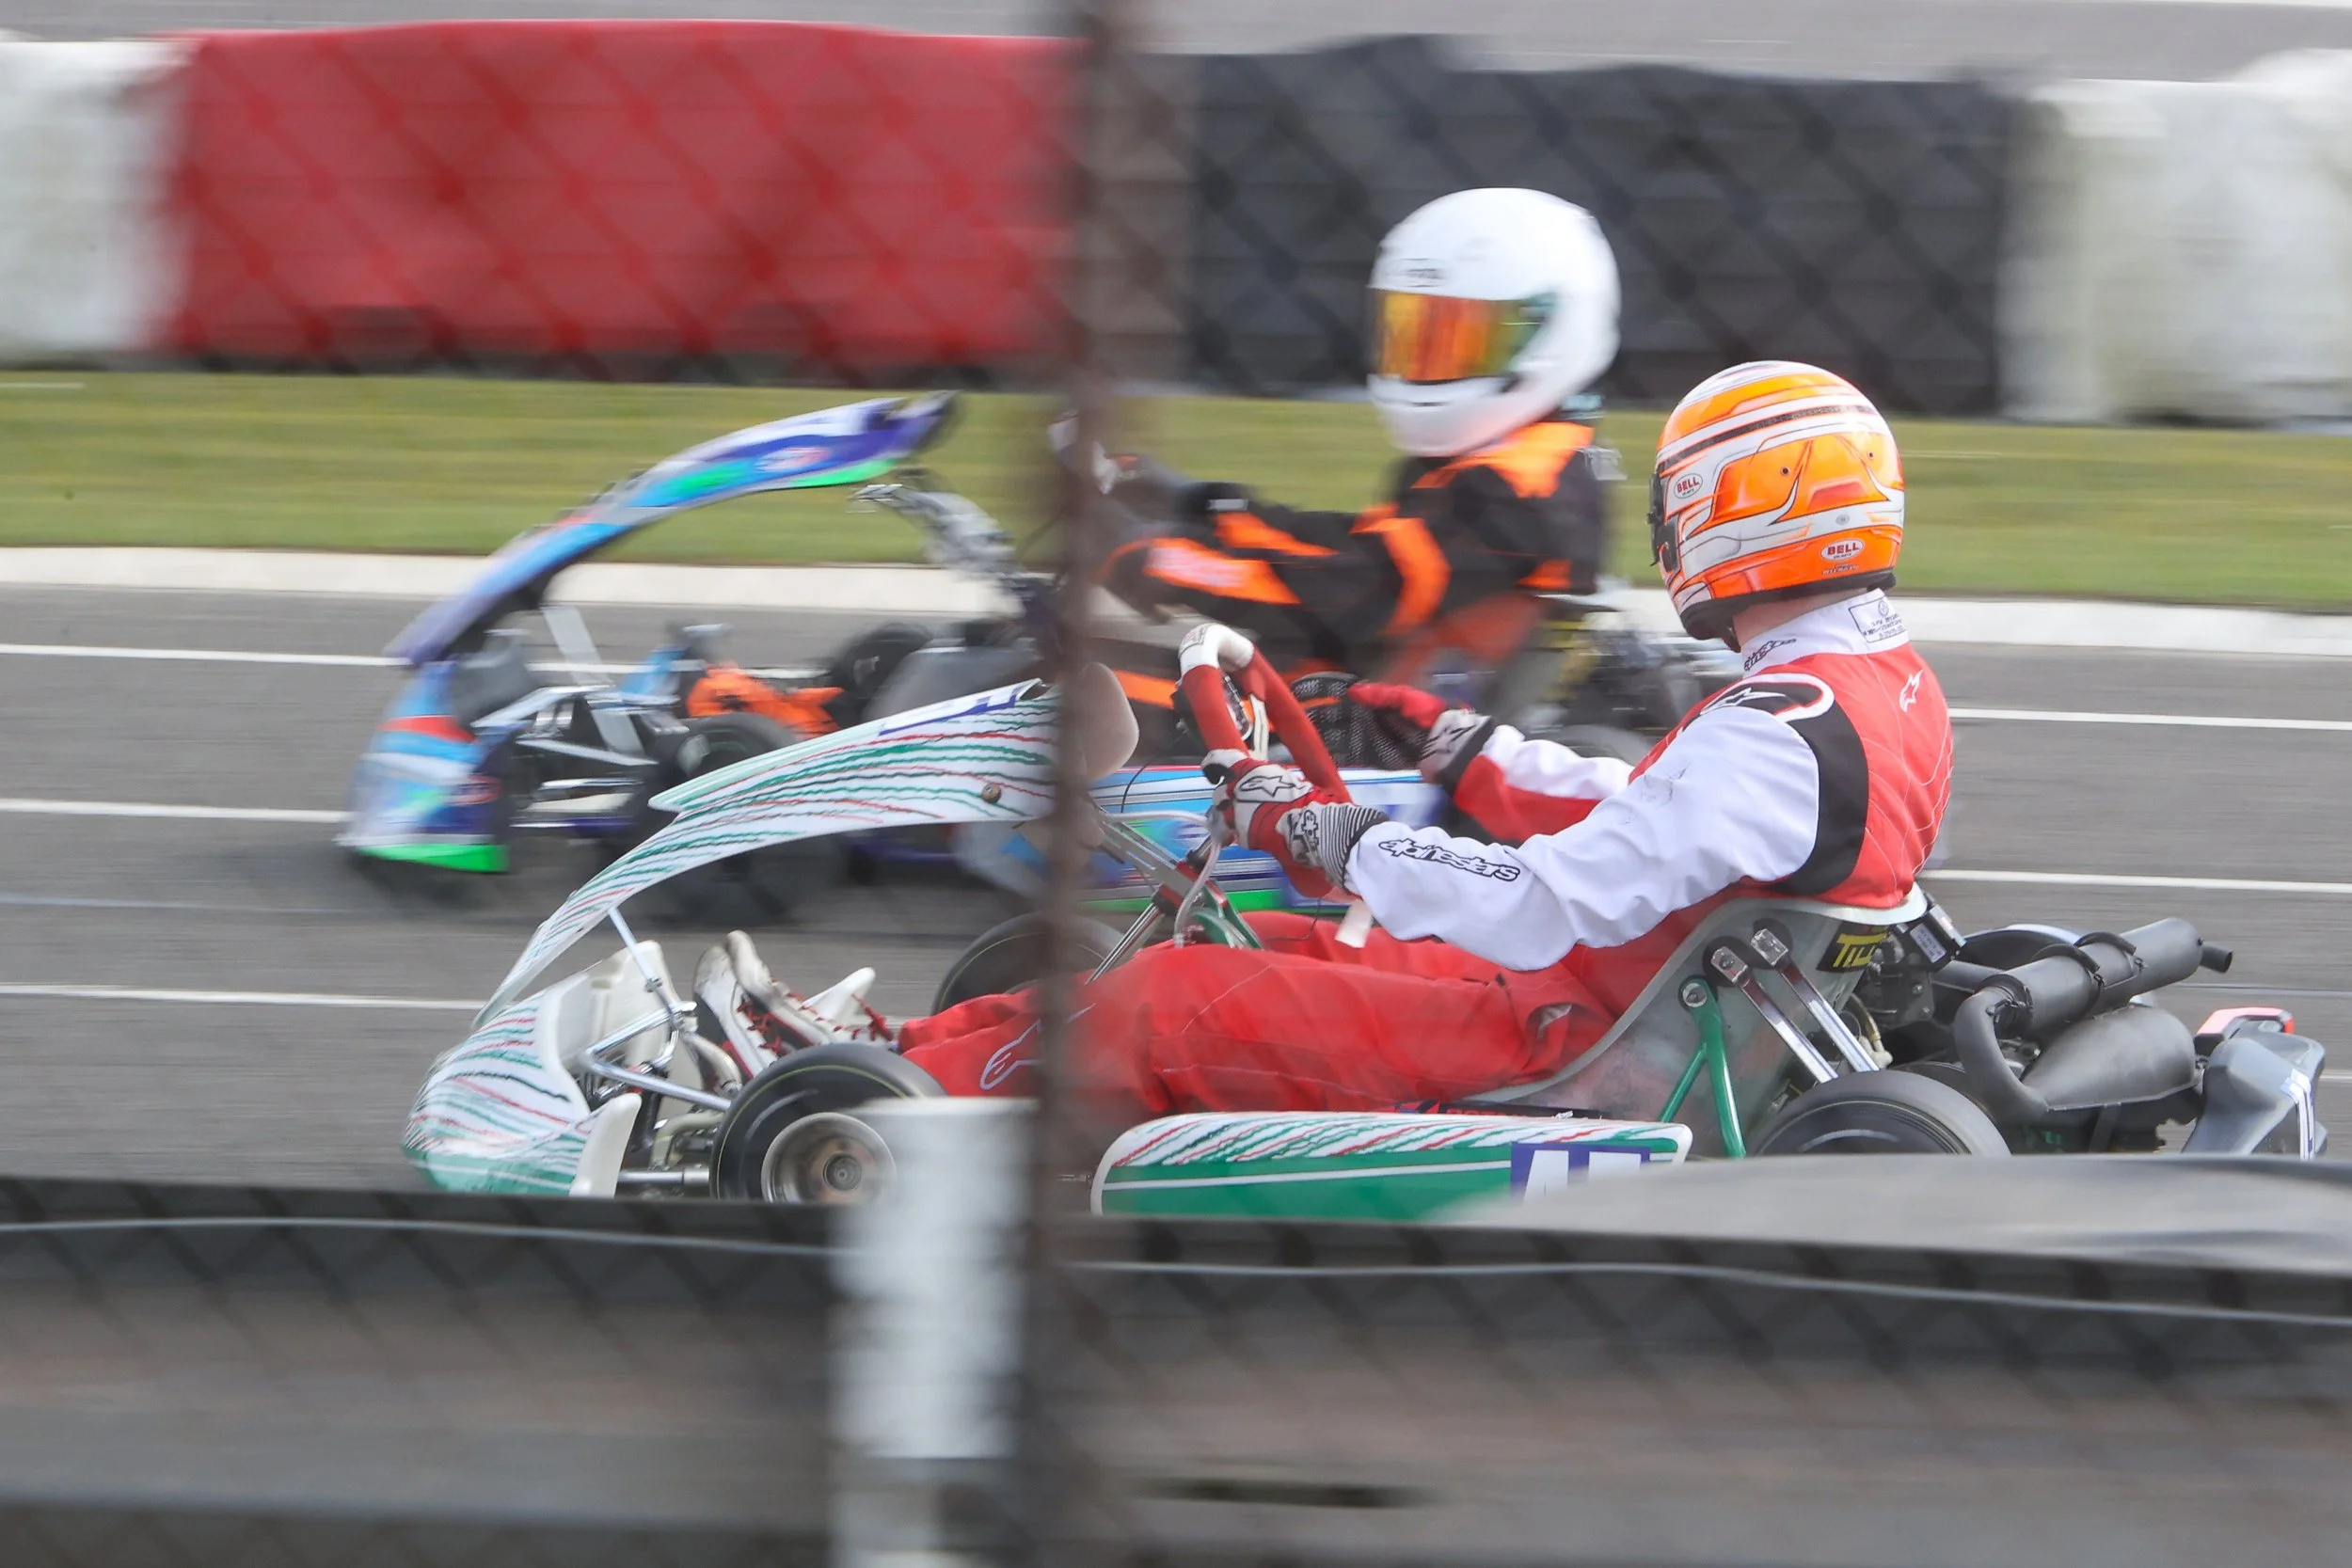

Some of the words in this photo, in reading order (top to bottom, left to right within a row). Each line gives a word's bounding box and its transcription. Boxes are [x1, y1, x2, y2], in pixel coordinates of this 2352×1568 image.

[1677, 476, 1700, 493] BELL
[1827, 542, 1860, 555] BELL
[1378, 838, 1520, 882] alpinestars
